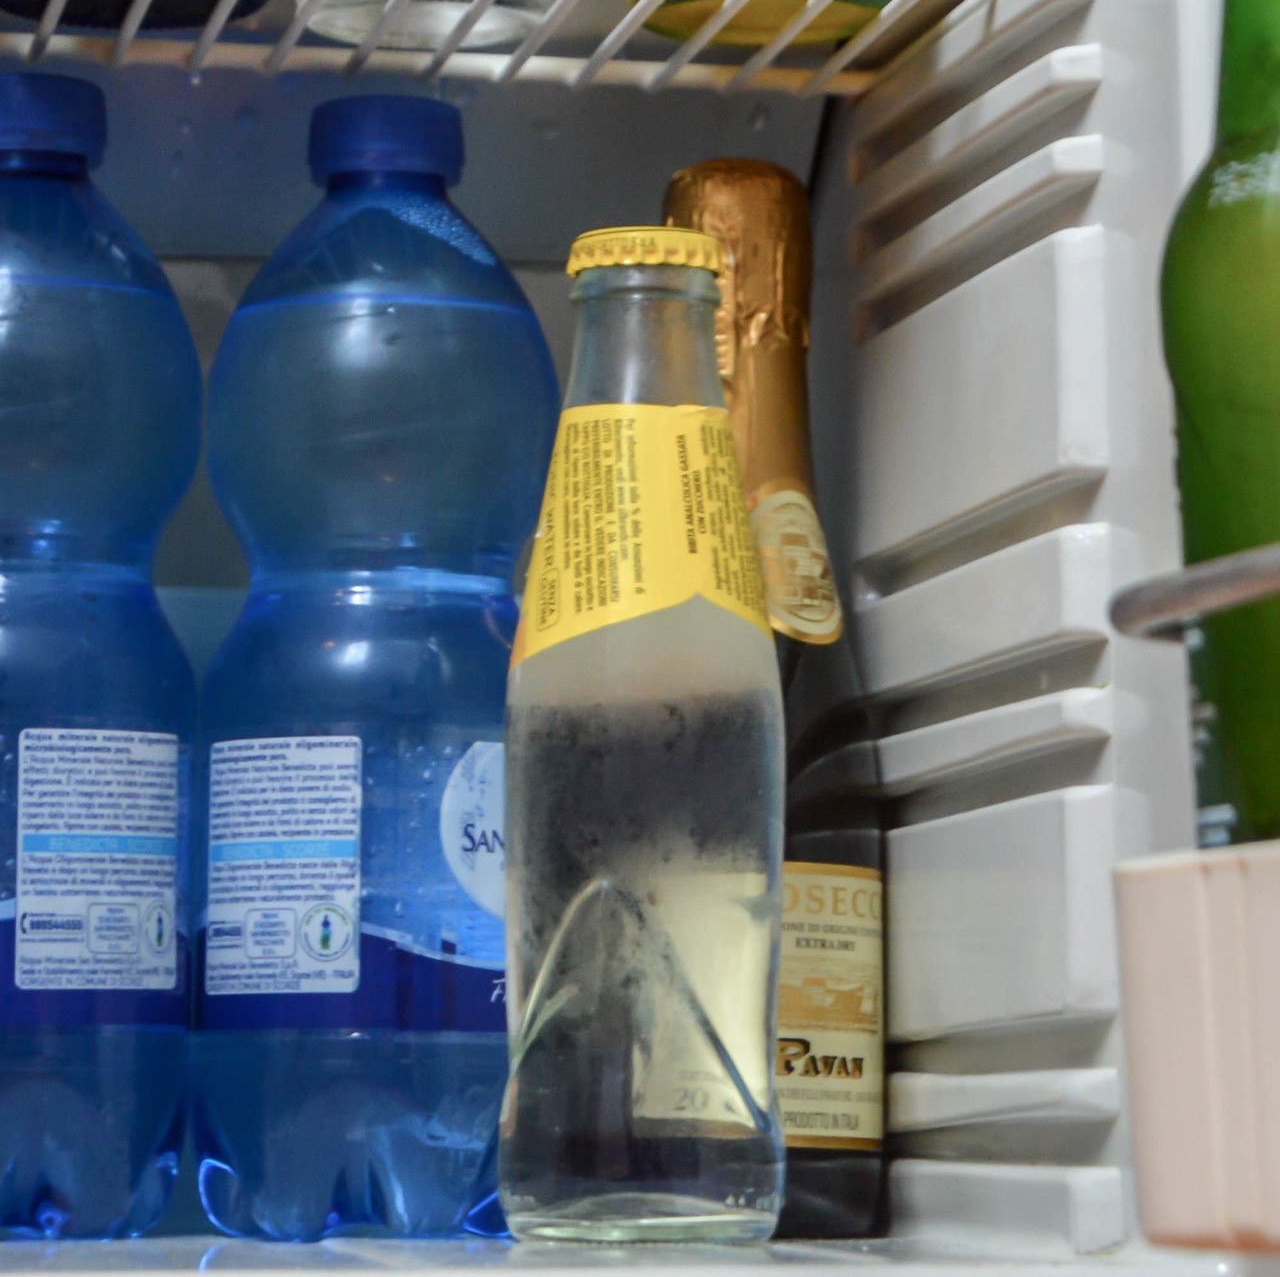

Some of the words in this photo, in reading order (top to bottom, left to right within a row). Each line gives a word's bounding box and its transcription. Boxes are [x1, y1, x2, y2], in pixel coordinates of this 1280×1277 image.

[603, 419, 611, 443] LOTTO
[677, 435, 689, 471] GASSATA
[682, 474, 695, 525] ANALCOLICA
[696, 516, 706, 534] CON
[25, 731, 53, 743] Acqua
[58, 732, 97, 743] minerale
[102, 734, 135, 743] naturale
[296, 741, 358, 750] oligominerale
[461, 823, 506, 853] SAN
[795, 937, 834, 950] EXTRA
